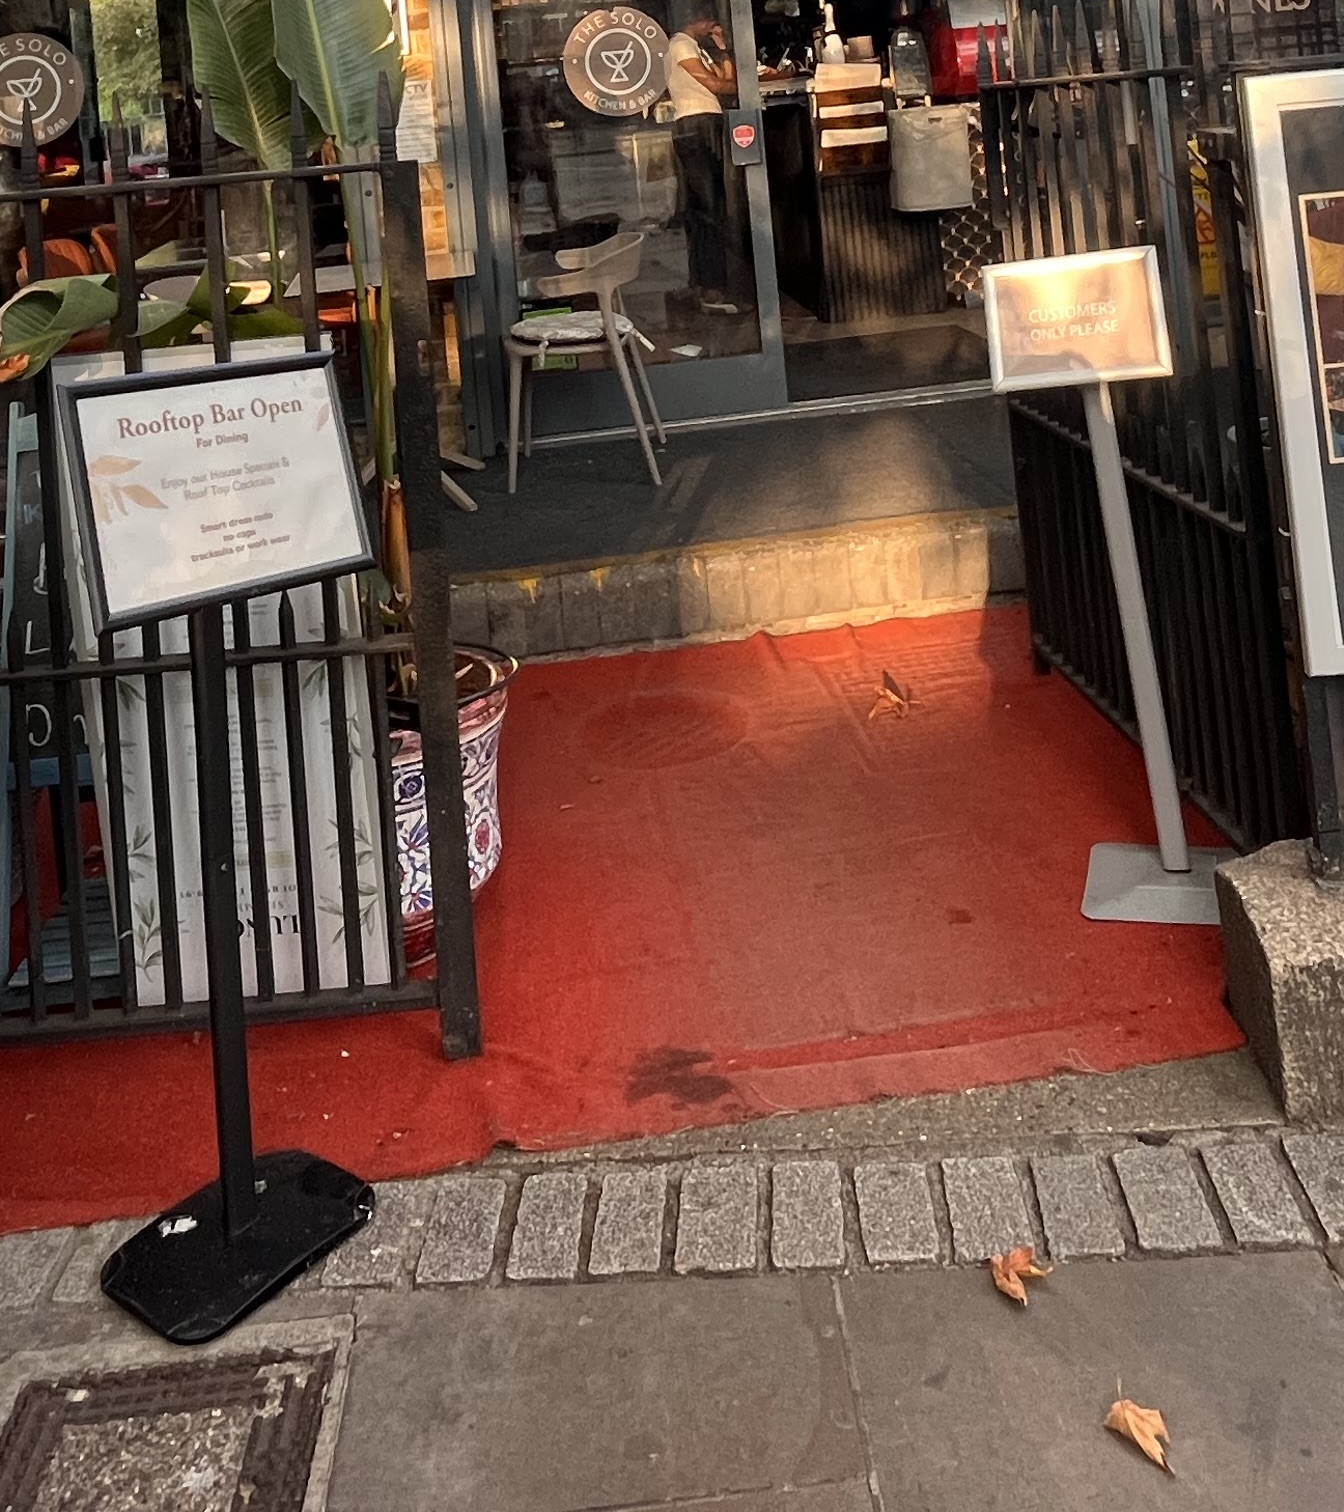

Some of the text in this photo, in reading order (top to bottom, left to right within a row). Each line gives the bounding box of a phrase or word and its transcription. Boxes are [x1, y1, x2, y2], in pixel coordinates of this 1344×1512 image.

[573, 11, 657, 44] THE SOLO
[15, 37, 67, 66] SOLO
[584, 90, 626, 110] KITCHEN
[637, 88, 656, 106] BAR
[47, 117, 69, 136] BAR
[1028, 300, 1117, 323] CUSTOMERS
[1030, 319, 1119, 342] ONLY PLEASE
[117, 397, 304, 439] Rooftop Bar Open
[196, 433, 249, 448] For Dining
